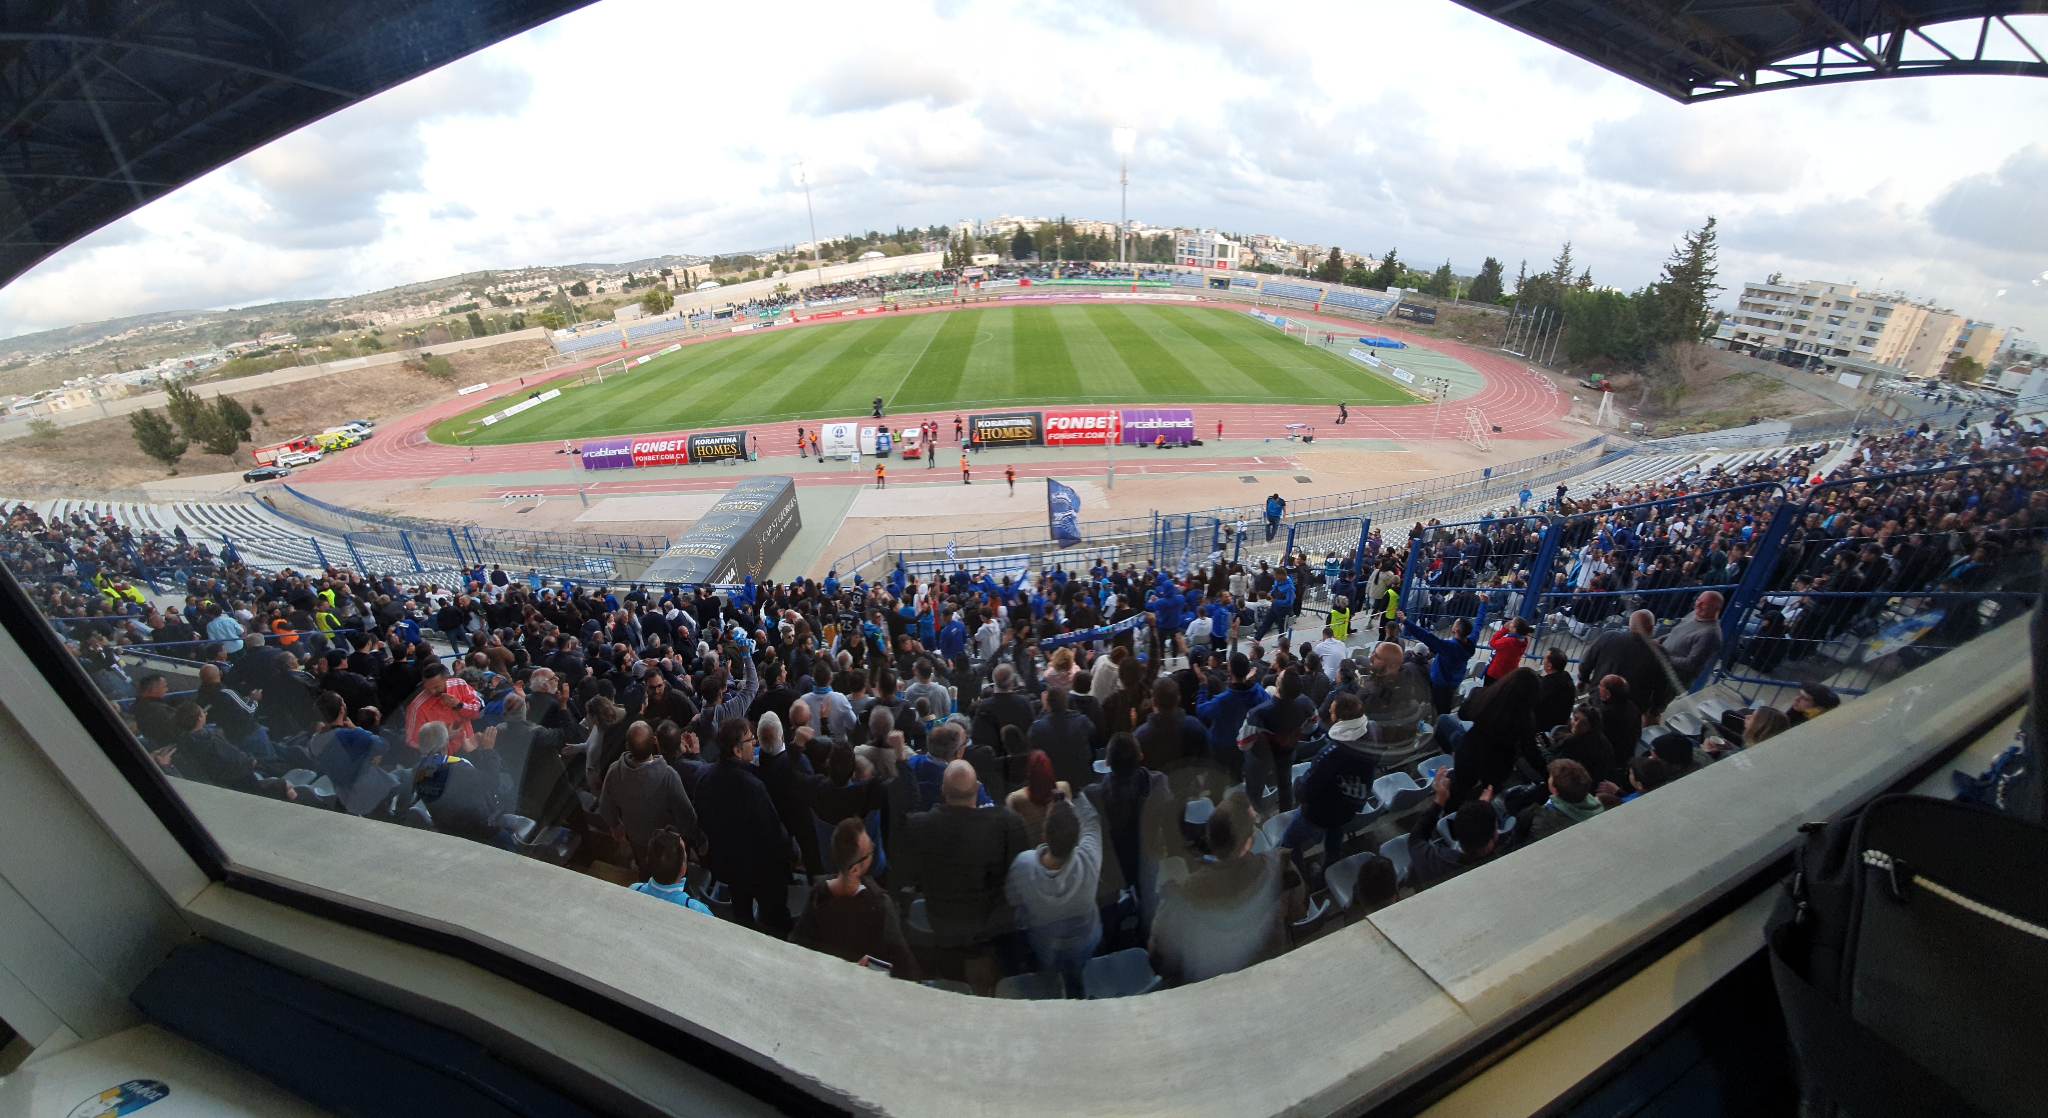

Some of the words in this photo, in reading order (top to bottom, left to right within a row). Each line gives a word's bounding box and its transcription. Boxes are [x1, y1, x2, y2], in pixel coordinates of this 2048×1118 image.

[1047, 416, 1118, 430] FONBET
[1134, 417, 1194, 429] cablenet
[980, 426, 1033, 440] HOMES
[633, 439, 685, 454] FONBET
[695, 436, 737, 446] KORANTINA
[588, 445, 630, 458] cablenet
[697, 443, 737, 456] HOMES
[635, 453, 685, 462] FONBET.COM.CY
